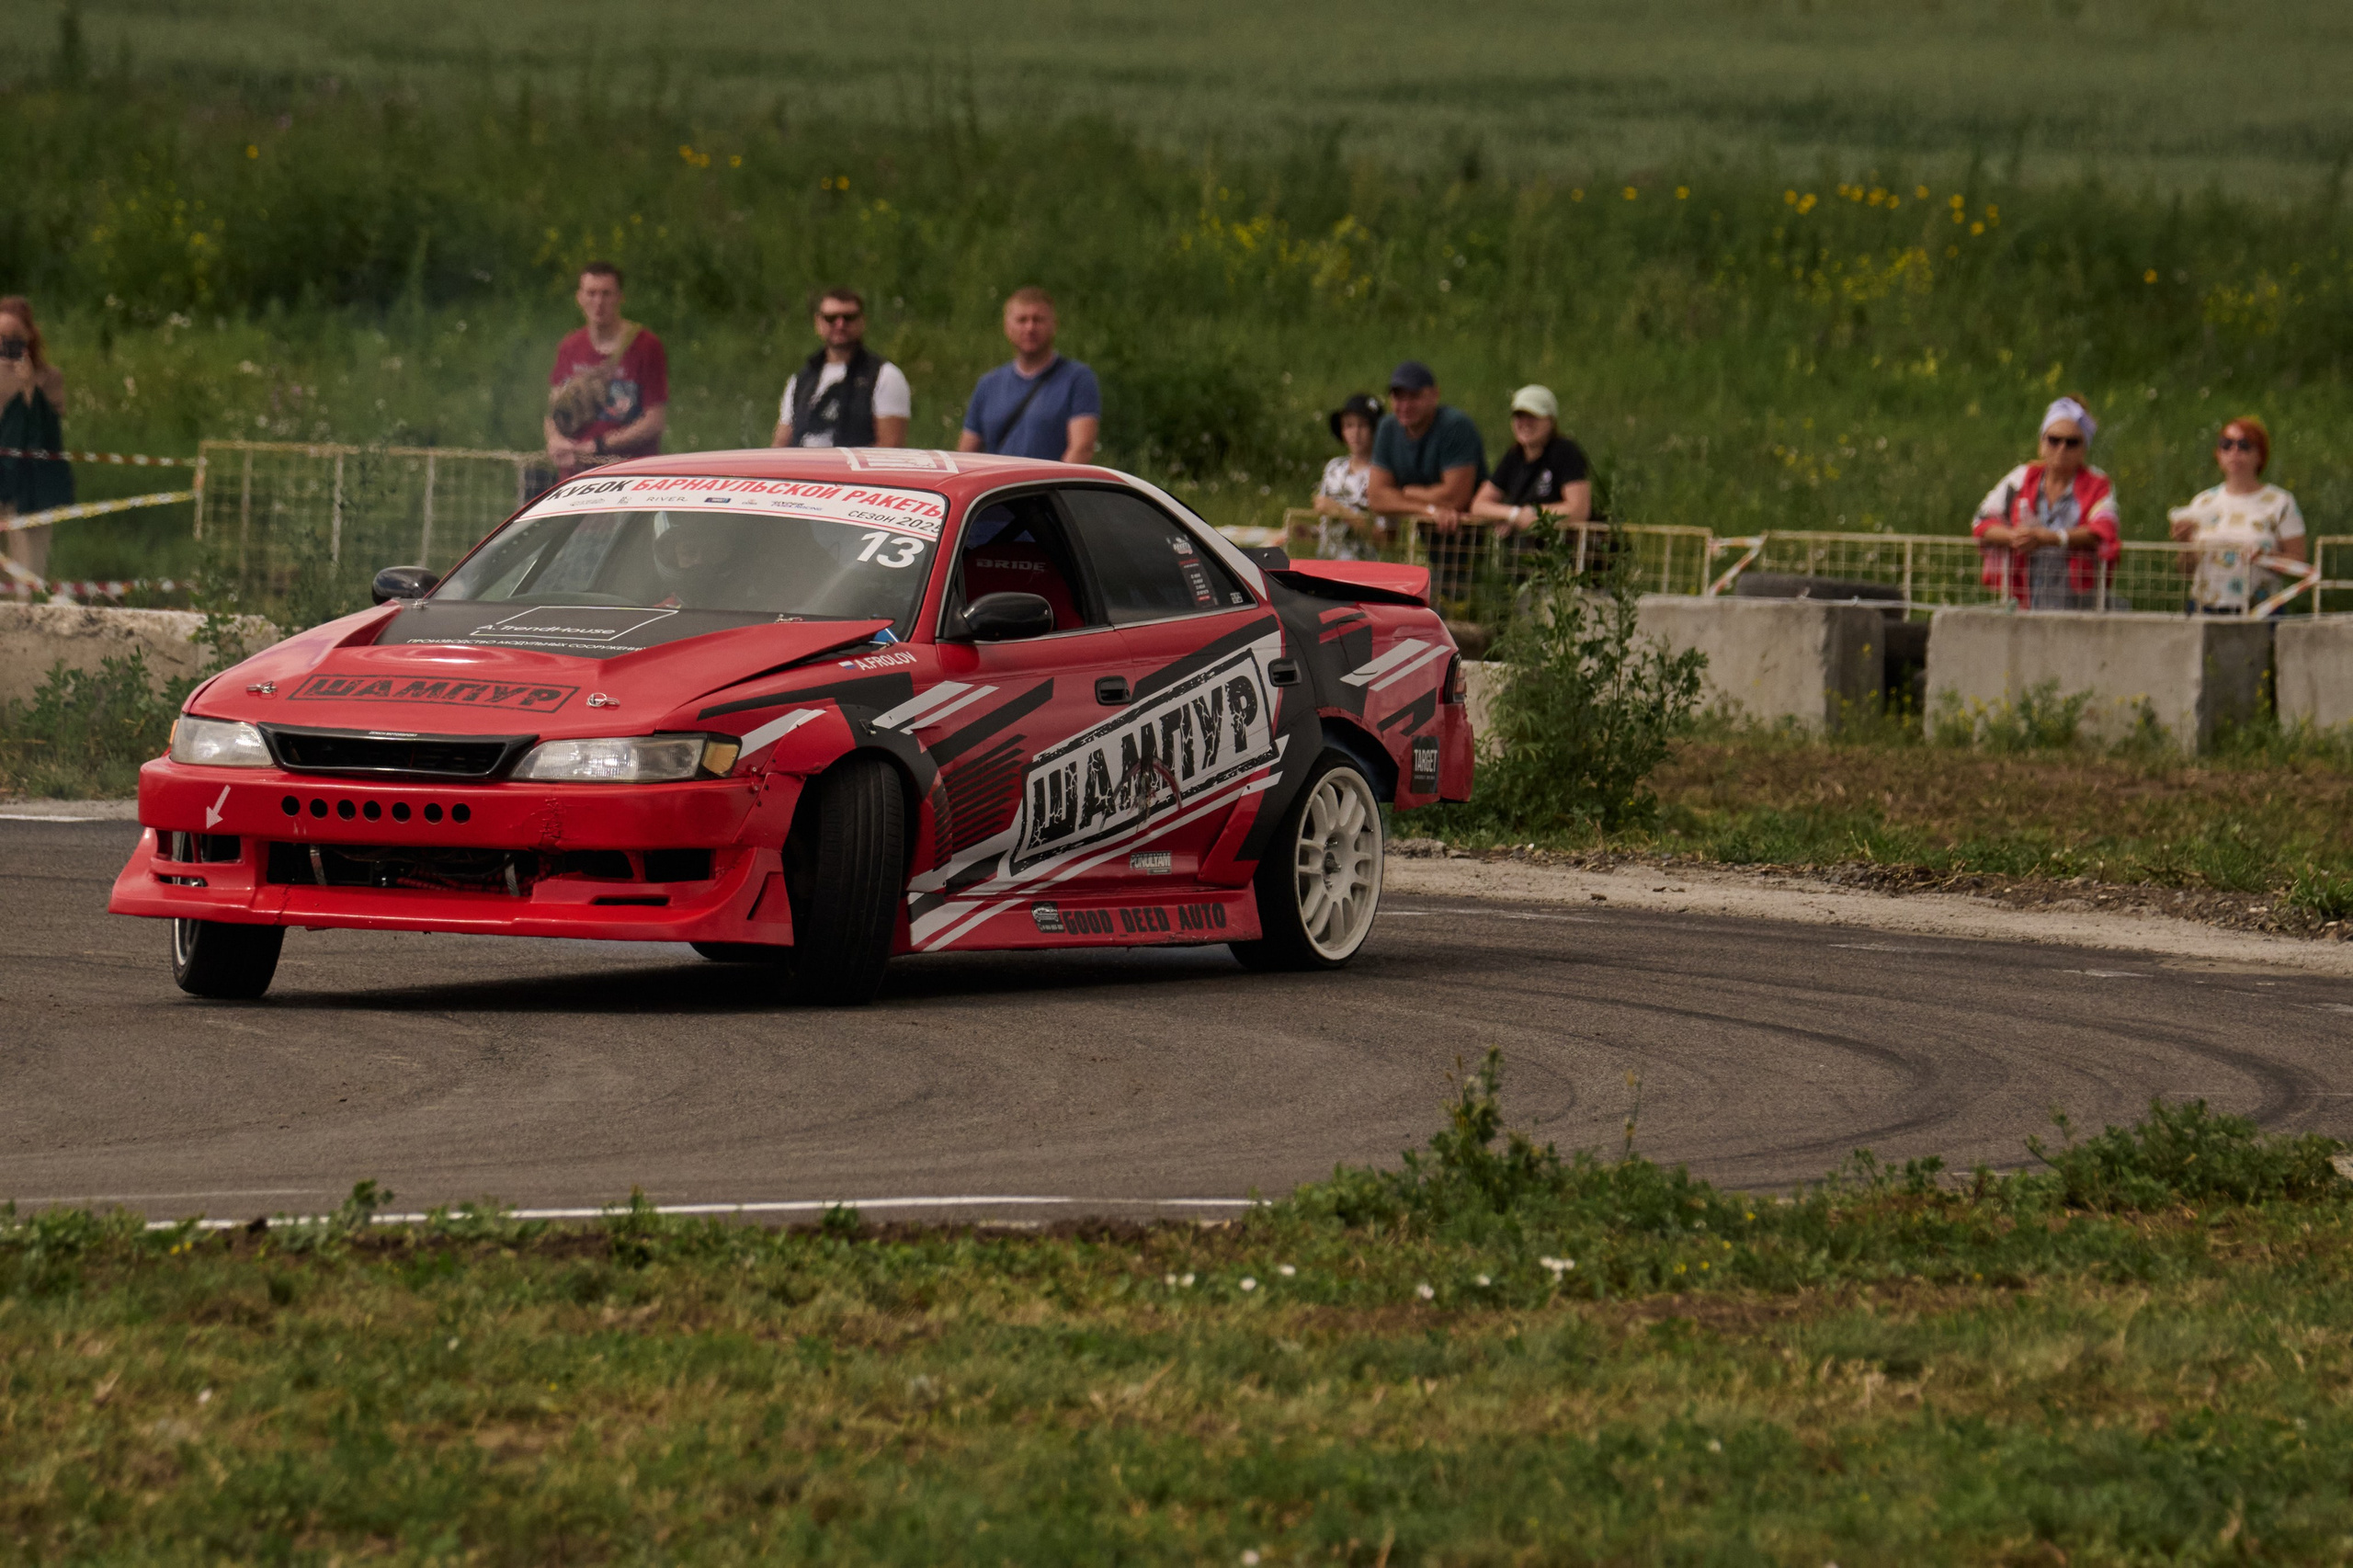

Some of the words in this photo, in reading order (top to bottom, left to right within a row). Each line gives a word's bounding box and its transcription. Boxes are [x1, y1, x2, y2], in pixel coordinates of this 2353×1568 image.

[547, 480, 634, 500] КУБОК
[631, 479, 844, 499] БАРНАУЛЬСКОЙ
[842, 490, 943, 519] РАКЕТЫ
[848, 511, 895, 523] СЕЗОН
[896, 517, 940, 533] 2025
[857, 531, 925, 568] 13
[976, 559, 1046, 573] BRIDE
[855, 651, 917, 671] A.FROLOV
[302, 678, 562, 706] ШАМПУР
[1026, 675, 1258, 849] ШАМПУР
[1414, 749, 1438, 772] TARGET
